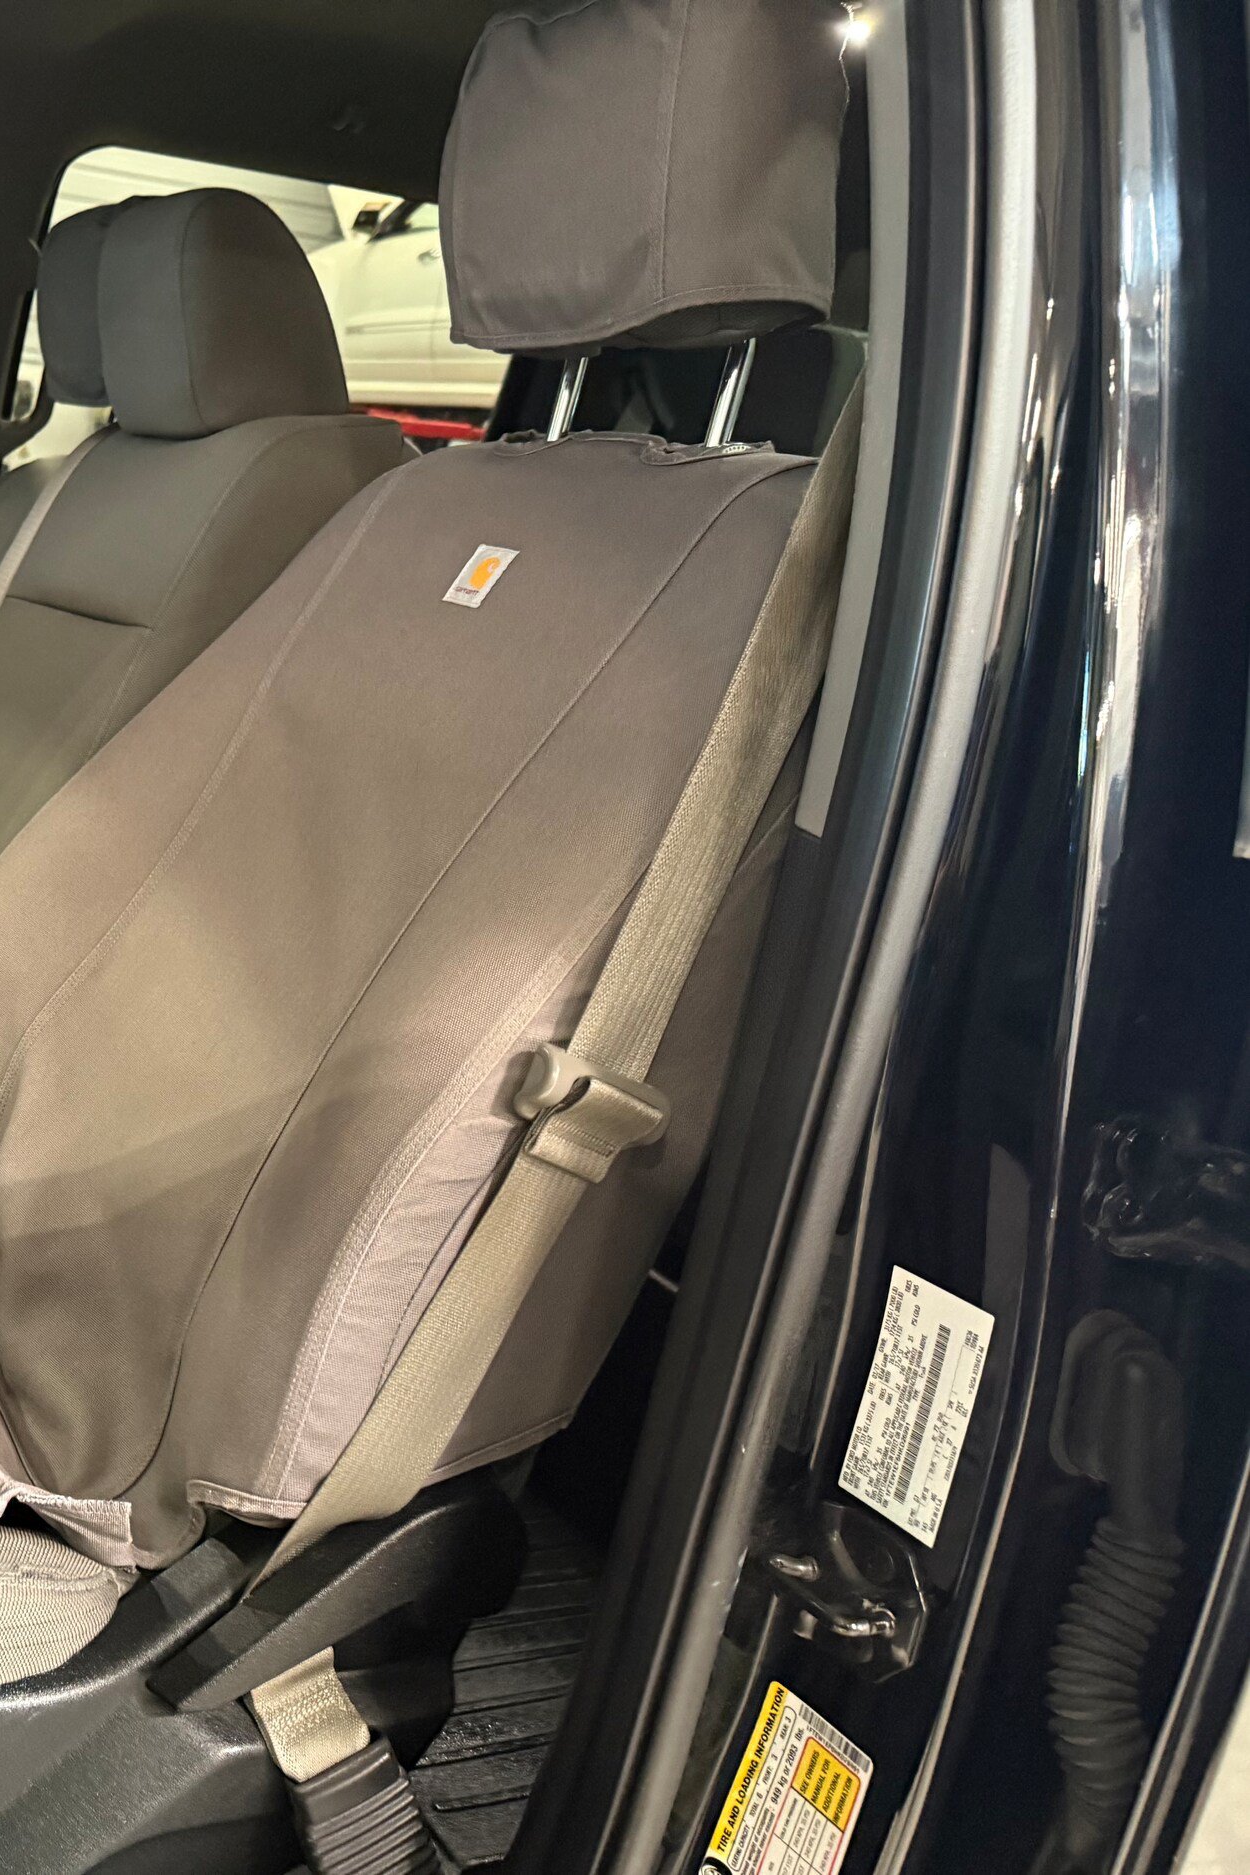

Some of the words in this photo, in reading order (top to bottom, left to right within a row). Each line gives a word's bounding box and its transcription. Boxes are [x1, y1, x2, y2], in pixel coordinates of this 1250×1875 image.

[794, 1728, 804, 1741] lbs.
[785, 1744, 798, 1766] 2093
[717, 1827, 732, 1852] TIRE
[727, 1805, 739, 1828] AND
[736, 1760, 758, 1804] LOADING
[755, 1688, 784, 1758] INFORMATION
[777, 1775, 788, 1787] kg
[783, 1765, 790, 1776] or
[799, 1780, 809, 1794] SEE
[805, 1750, 819, 1779] OWNERS
[810, 1775, 825, 1803] MANUAL
[821, 1758, 830, 1774] FOR
[770, 1787, 781, 1804] 949
[822, 1772, 840, 1812] ADDITIONAL
[833, 1776, 852, 1823] INFORMATION
[738, 1824, 749, 1848] CAPACITY
